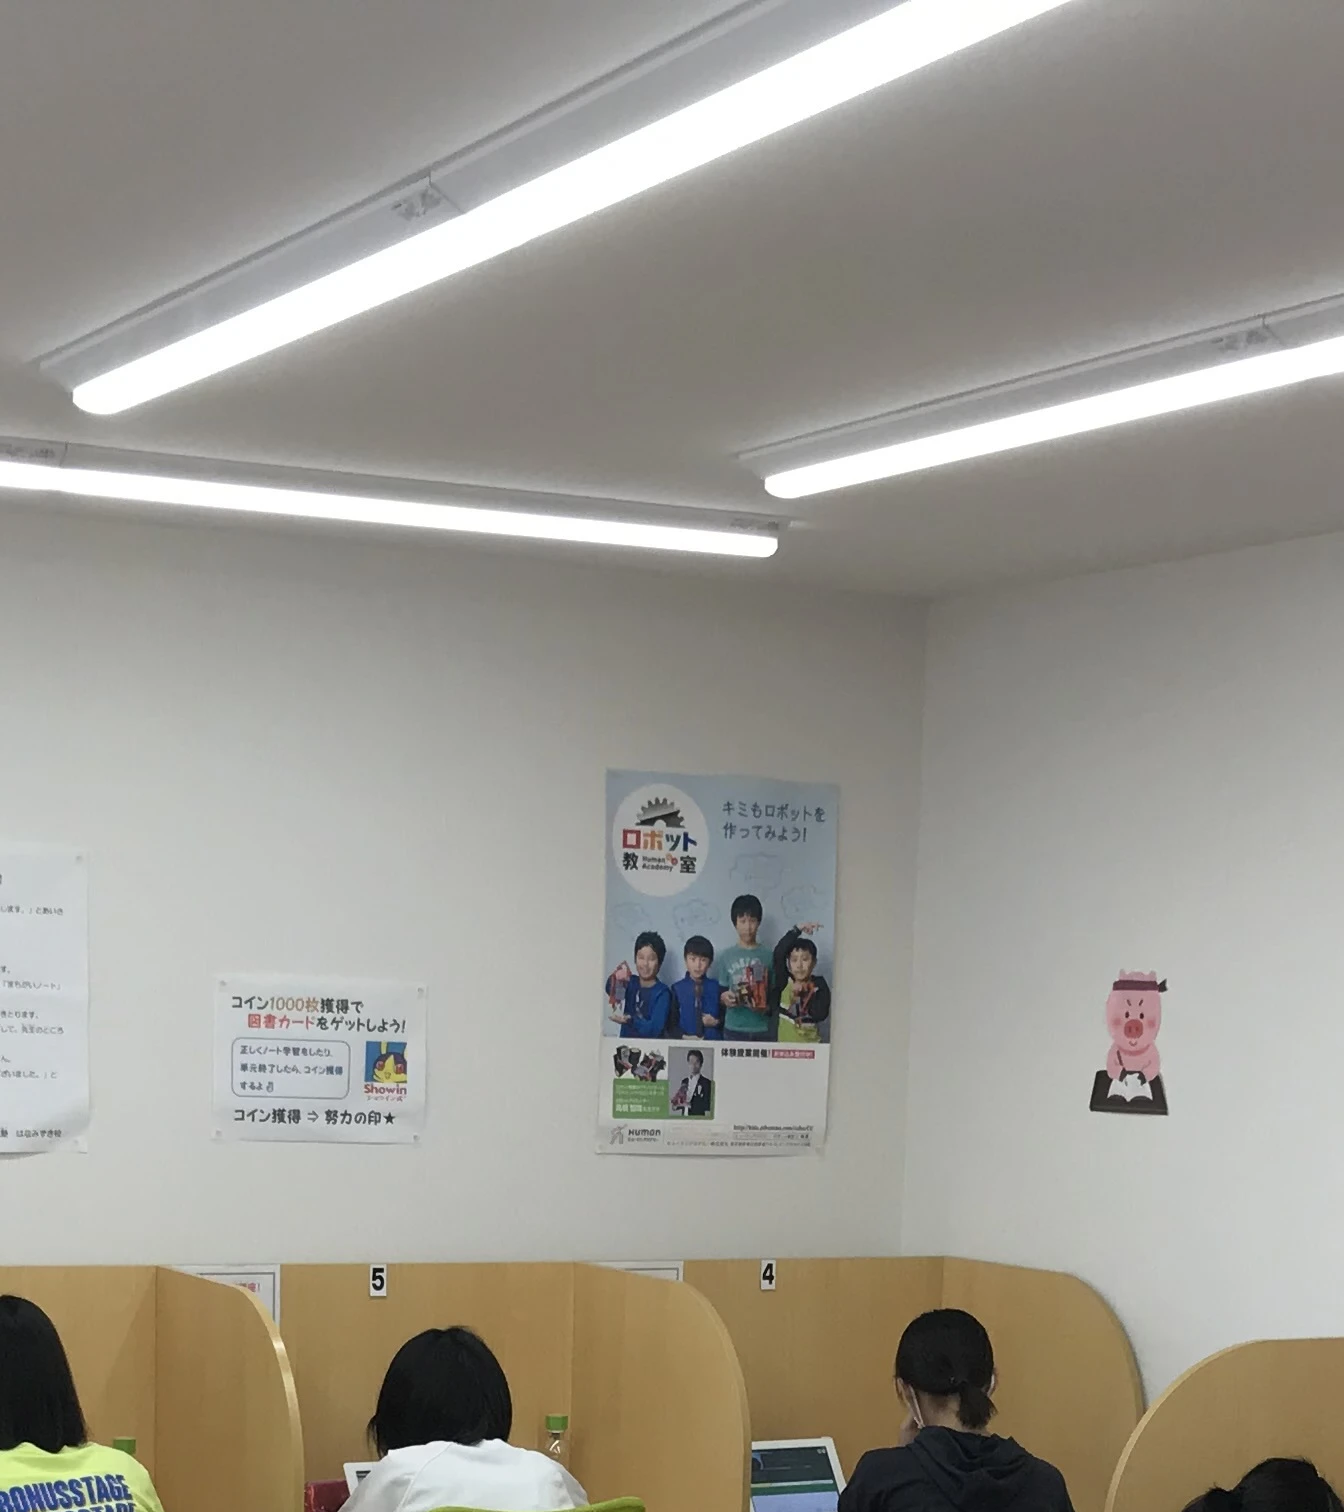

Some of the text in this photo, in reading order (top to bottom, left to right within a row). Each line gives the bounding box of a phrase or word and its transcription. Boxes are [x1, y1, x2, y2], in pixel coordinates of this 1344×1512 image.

[722, 800, 826, 822] キミもロボットを
[622, 828, 698, 852] ロボット
[723, 822, 807, 843] 作ってみよう!
[641, 855, 666, 863] Human
[641, 863, 674, 873] Academy
[231, 995, 364, 1014] コイン1000枚獲得で
[247, 1013, 406, 1034] 図書カードをゲットしよう!
[363, 1083, 408, 1095] Showin
[233, 1108, 301, 1124] コイン獲得
[371, 1267, 386, 1292] 5
[761, 1262, 775, 1286] 4
